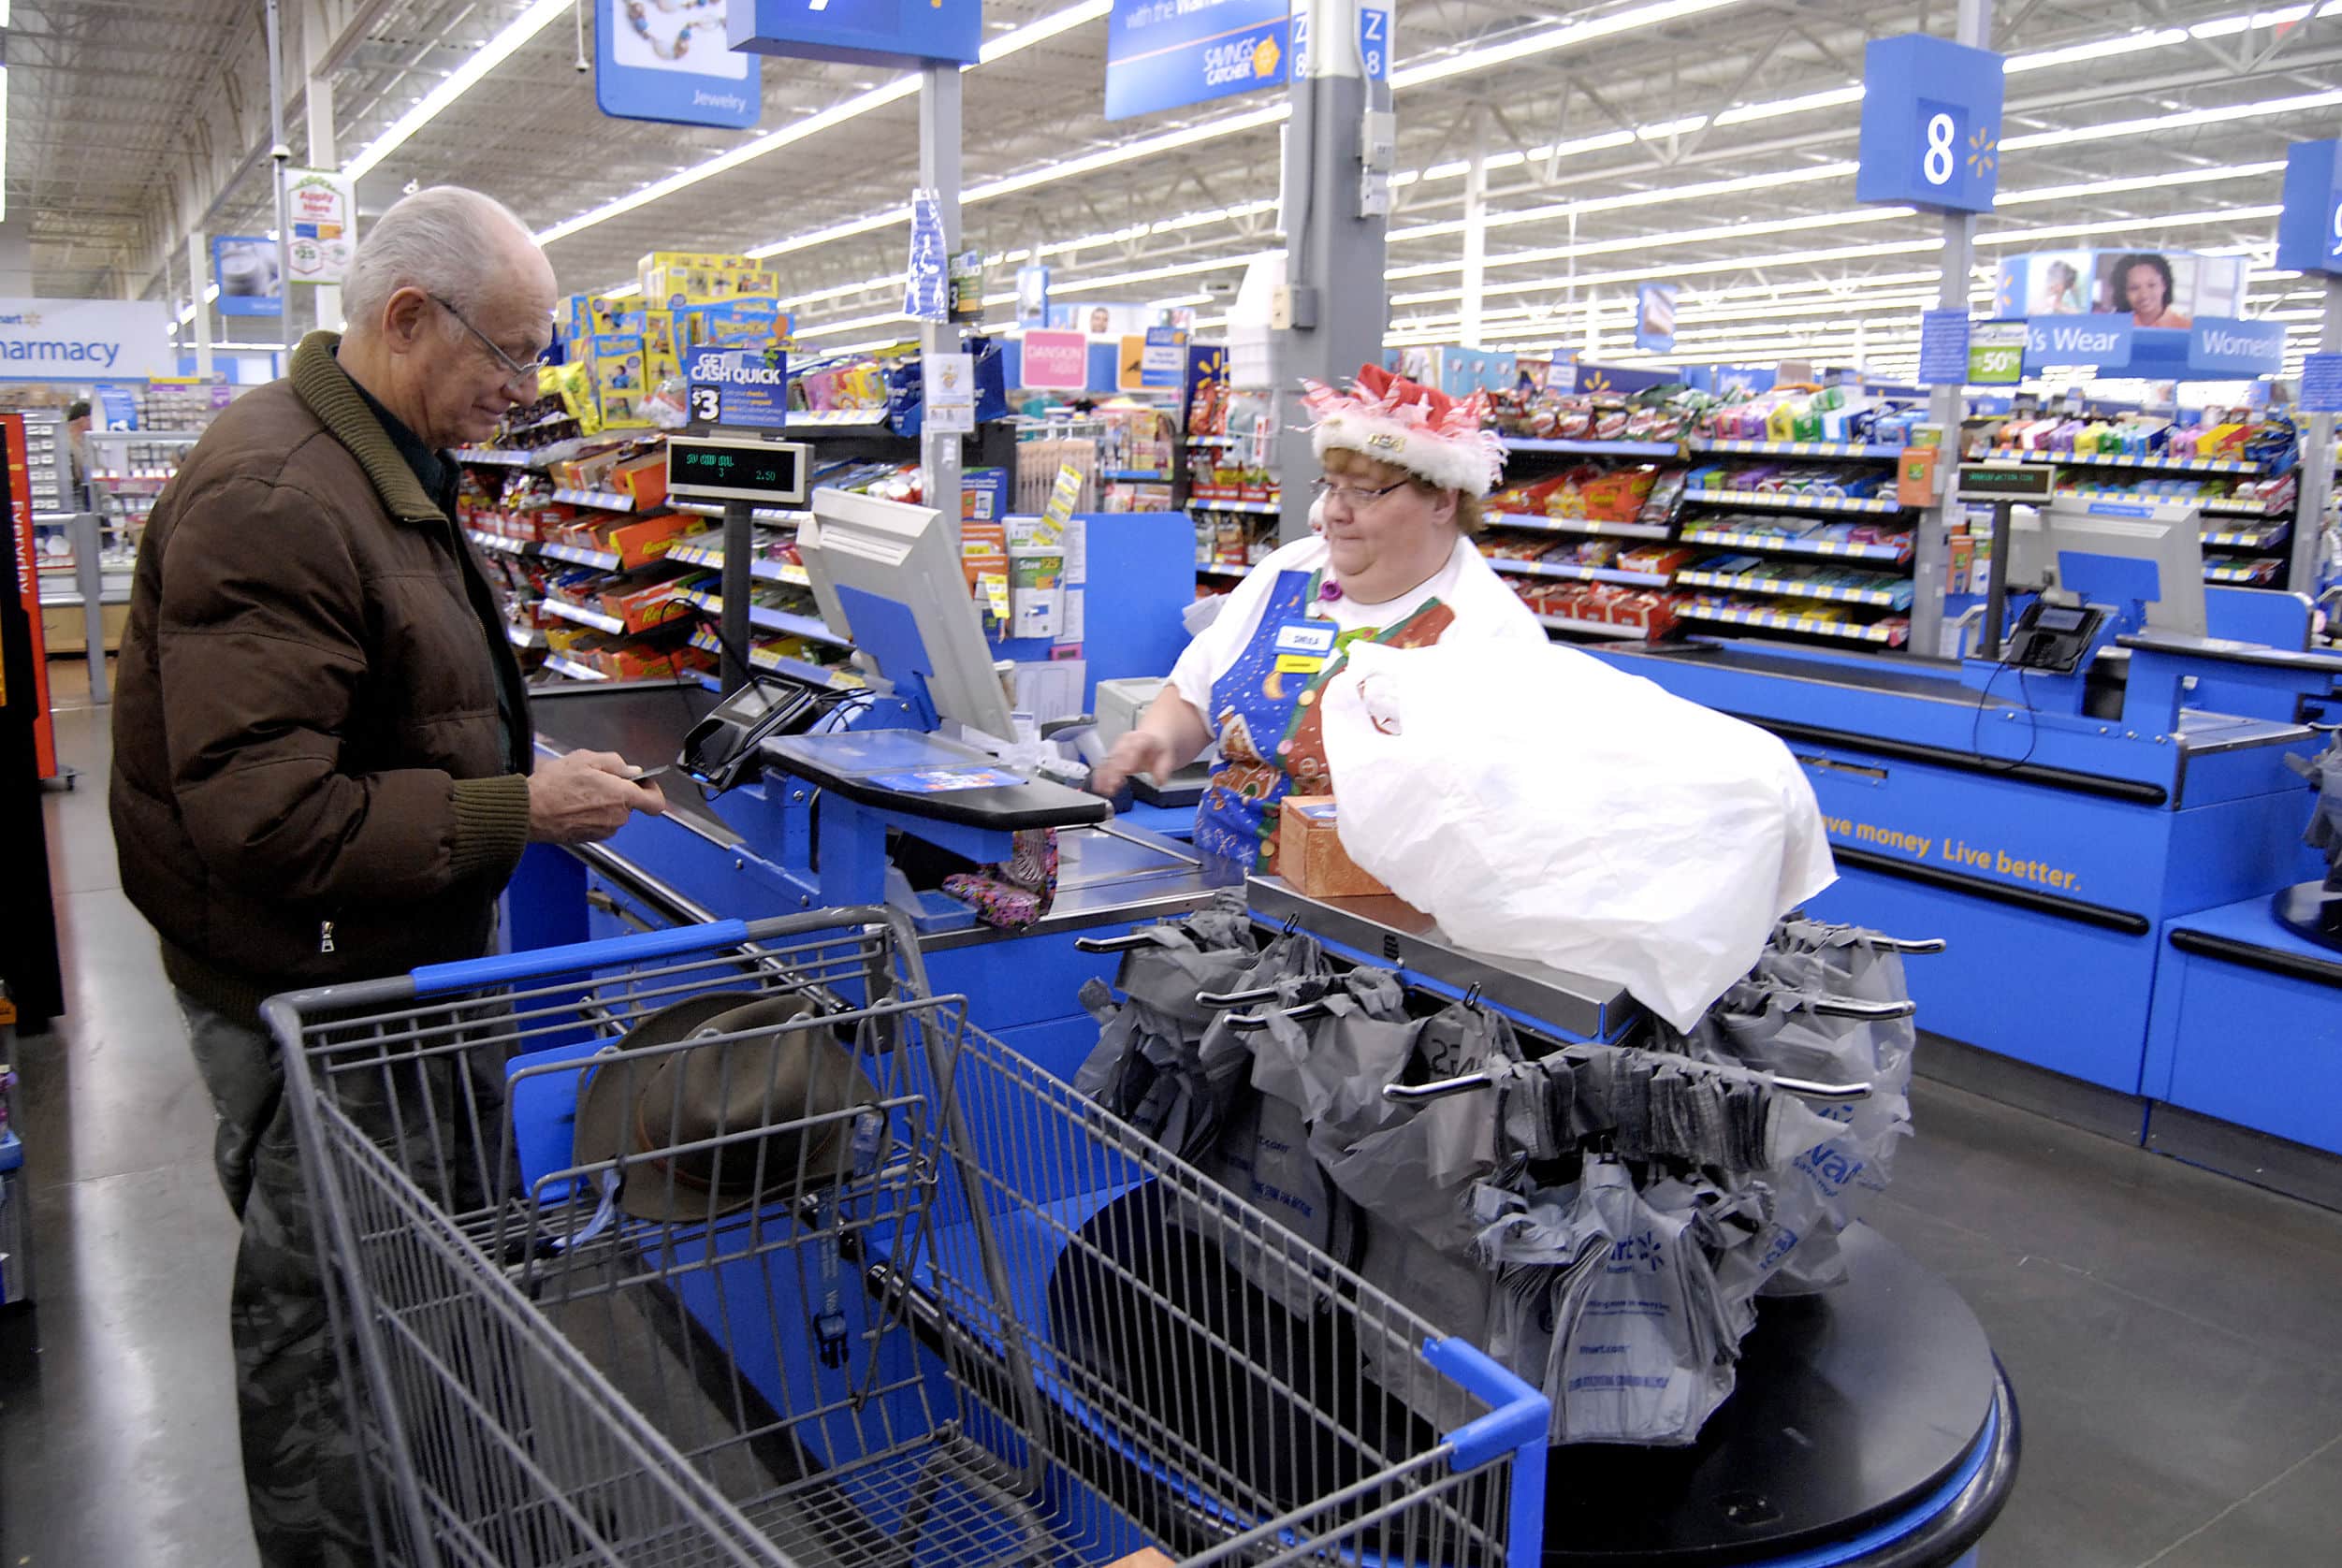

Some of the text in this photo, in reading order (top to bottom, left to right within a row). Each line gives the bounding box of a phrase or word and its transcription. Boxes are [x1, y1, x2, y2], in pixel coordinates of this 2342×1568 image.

[1365, 12, 1382, 41] Z
[1367, 50, 1380, 75] 8
[692, 90, 747, 112] Jewelry
[1924, 112, 1955, 185] 8
[2052, 327, 2119, 353] Wear
[699, 353, 726, 369] GET
[691, 366, 780, 385] CASH QUICK
[755, 469, 776, 481] 2.50
[11, 501, 31, 593] Everyday
[1856, 821, 1932, 858] money
[1943, 838, 1991, 868] Live
[1997, 849, 2081, 891] better.
